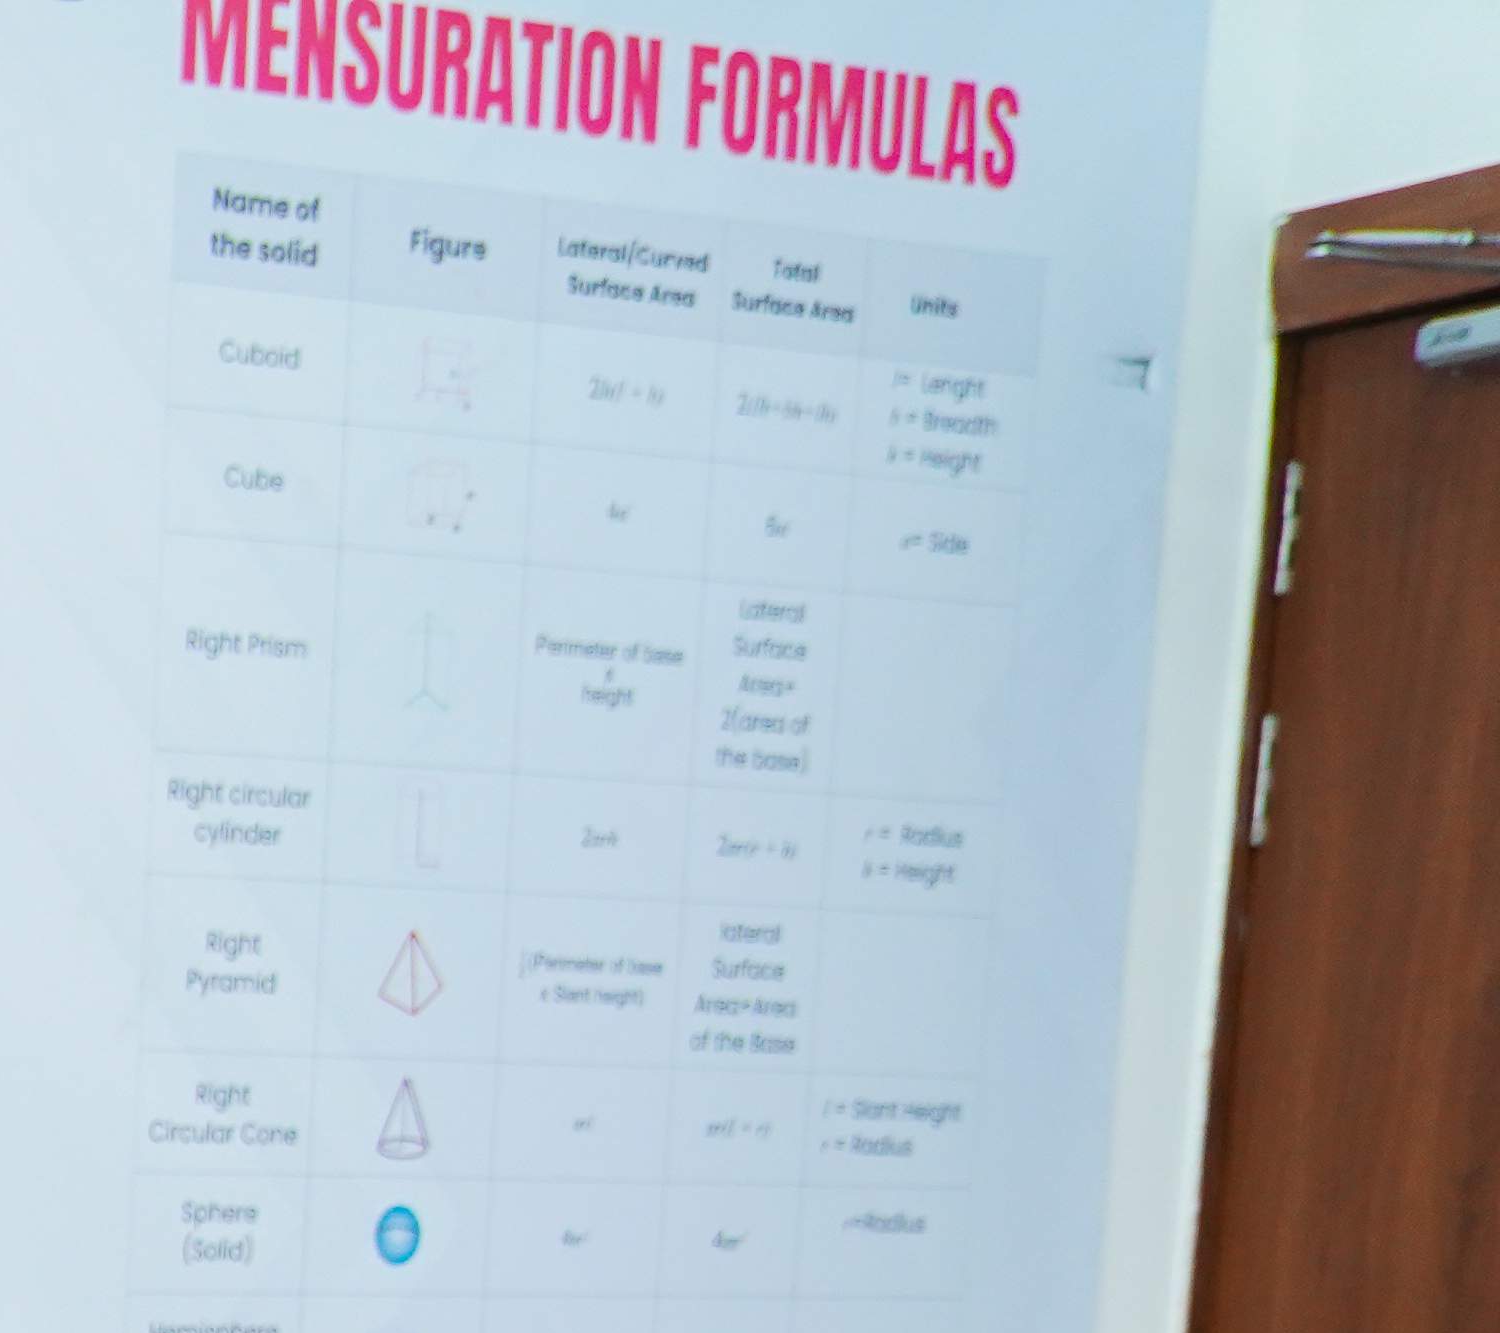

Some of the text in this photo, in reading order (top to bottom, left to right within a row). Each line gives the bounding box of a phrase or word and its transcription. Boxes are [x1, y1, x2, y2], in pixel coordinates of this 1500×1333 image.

[180, 0, 1020, 191] MENSURATION FORMULAS
[213, 186, 320, 222] Name of
[211, 232, 319, 268] the solid
[409, 227, 487, 263] Figure
[773, 257, 820, 283] Total
[909, 294, 959, 320] Units
[219, 338, 302, 371] Cuboid
[223, 464, 284, 492] Cube
[185, 628, 308, 660] Right Prism
[168, 779, 311, 811] Right circular
[194, 822, 281, 849] cylinder
[205, 930, 262, 961] Right
[186, 969, 278, 998] Pyramid
[195, 1083, 252, 1111] Right
[149, 1119, 300, 1148] Circular Cone
[181, 1200, 258, 1226] Sphere
[182, 1235, 255, 1266] (Solid)
